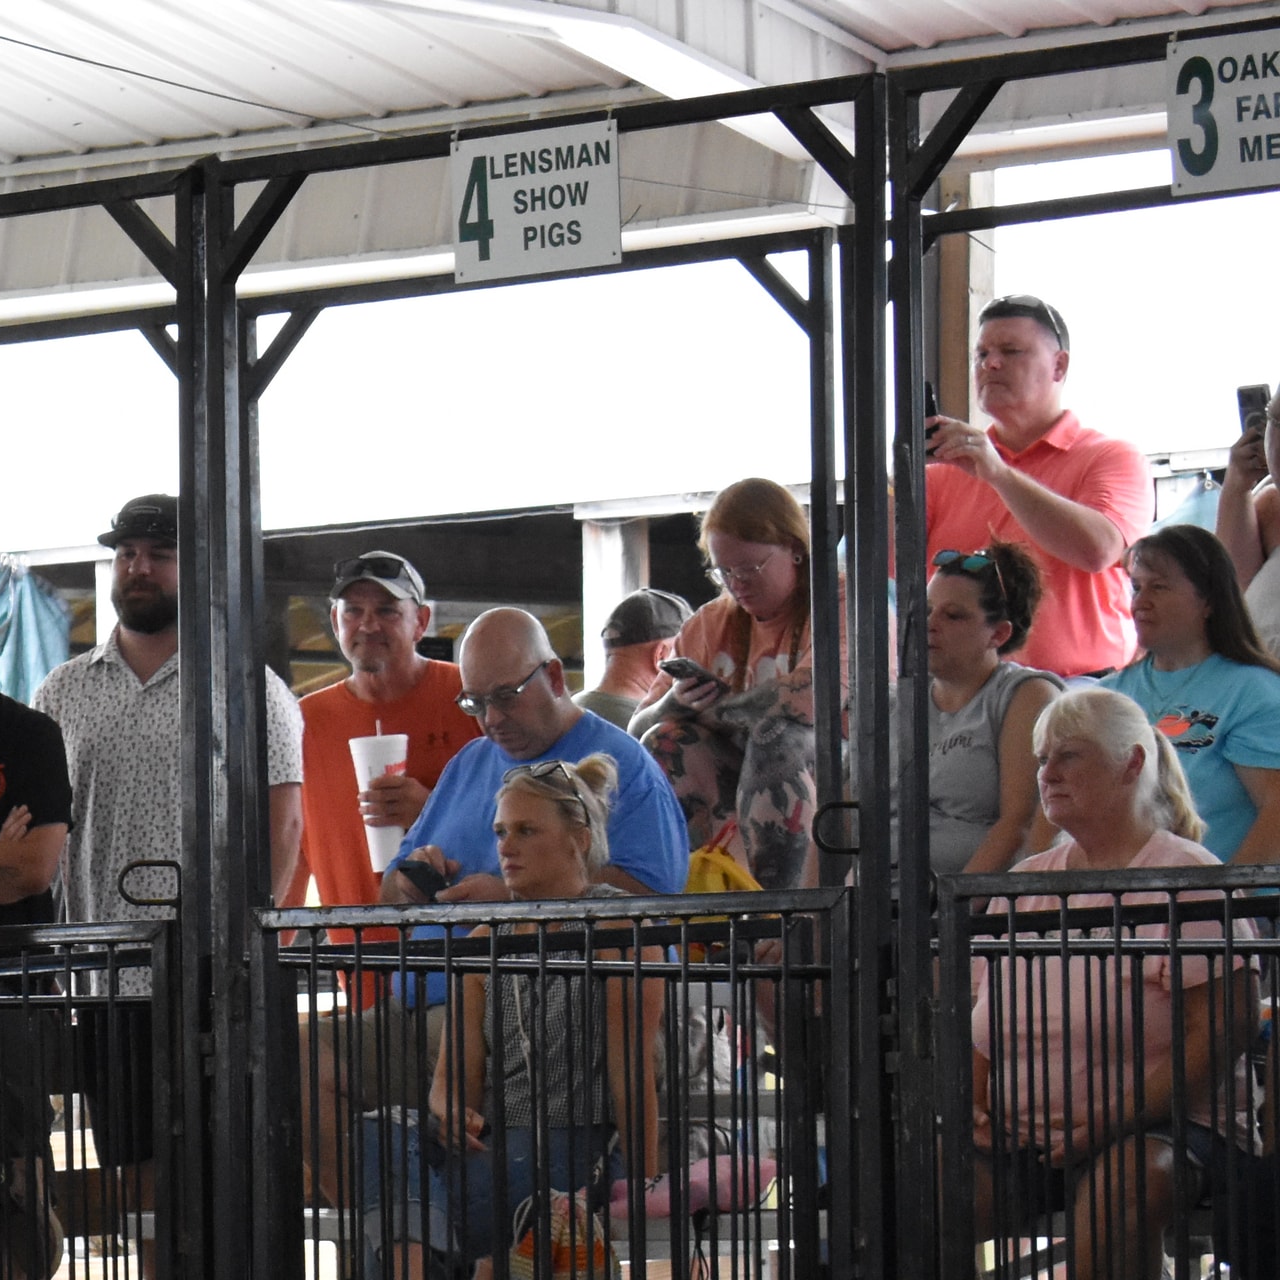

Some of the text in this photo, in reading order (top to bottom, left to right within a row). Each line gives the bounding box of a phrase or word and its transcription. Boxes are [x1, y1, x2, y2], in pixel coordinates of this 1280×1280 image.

[1218, 51, 1280, 83] OAK
[1176, 56, 1218, 176] 3
[489, 139, 611, 180] LENSMAN
[1239, 132, 1280, 163] ME
[458, 156, 494, 262] 4
[513, 181, 589, 214] SHOW
[523, 220, 582, 251] PIGS
